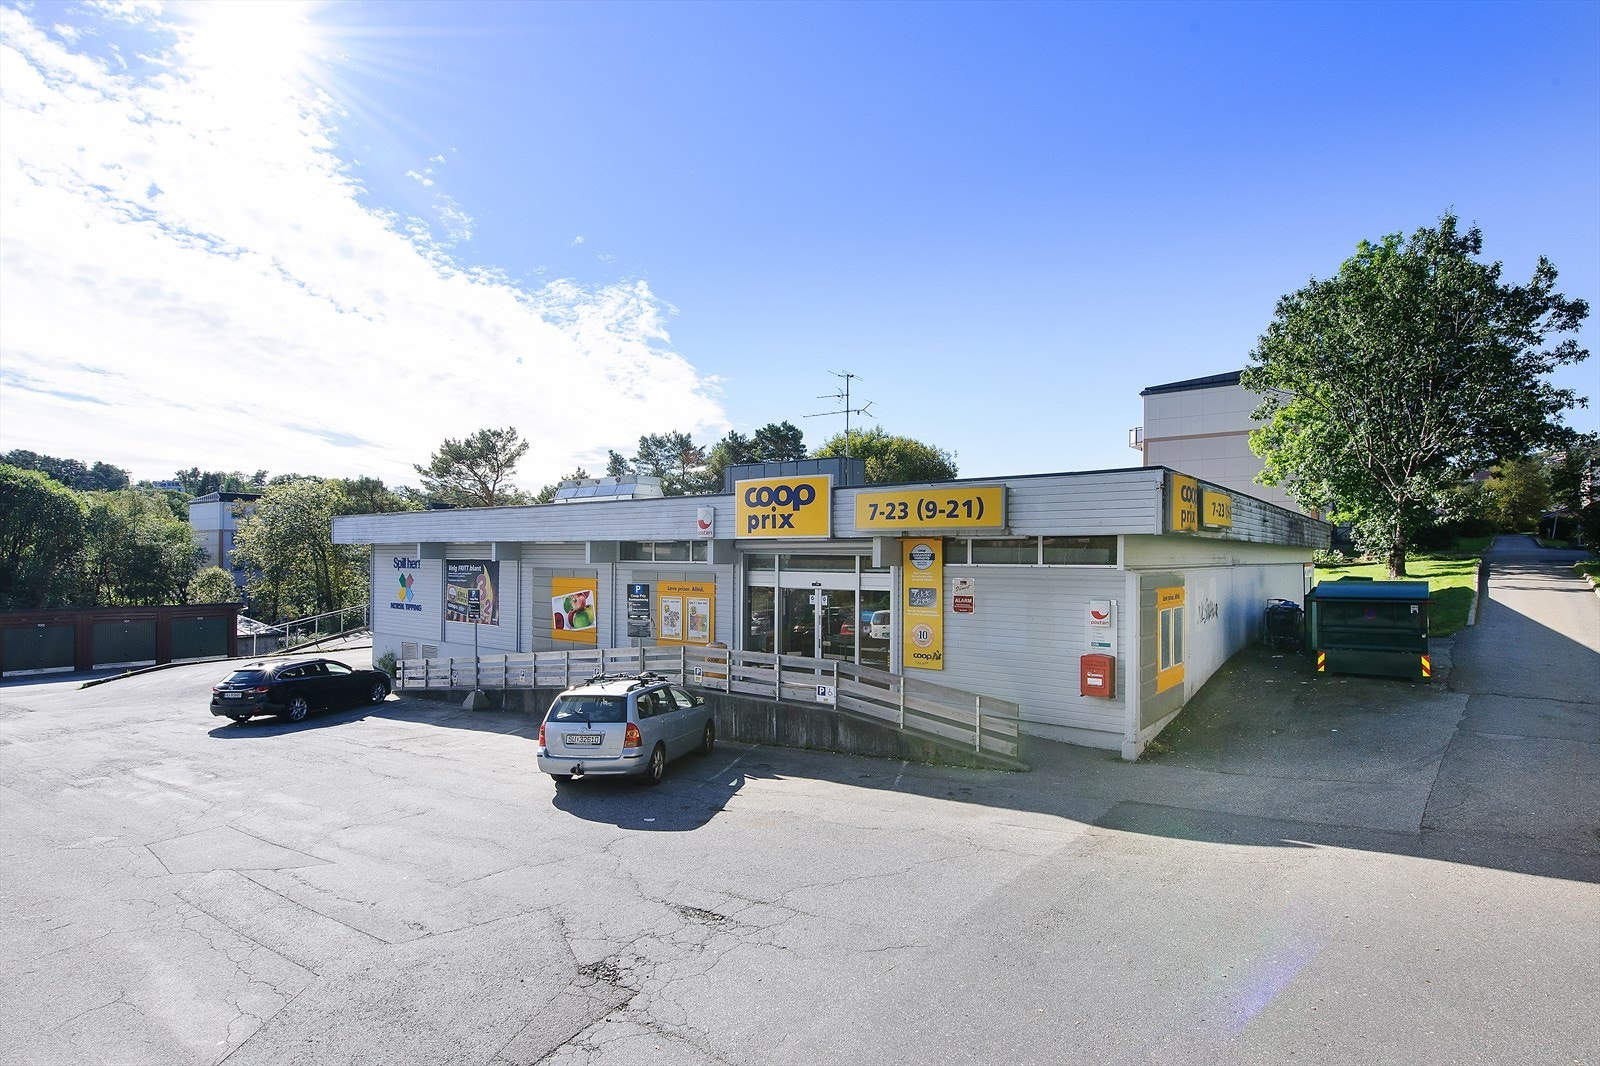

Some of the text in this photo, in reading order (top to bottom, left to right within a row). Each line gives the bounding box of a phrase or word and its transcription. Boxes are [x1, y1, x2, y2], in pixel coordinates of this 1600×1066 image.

[744, 483, 816, 511] coop
[868, 496, 985, 521] 7-23 (9-21)
[1180, 503, 1196, 528] prix
[1211, 501, 1225, 518] 7-23
[747, 506, 795, 533] prix
[393, 557, 407, 571] Spill
[458, 564, 469, 572] FRITT
[469, 564, 482, 572] blant
[476, 573, 487, 601] 3
[635, 585, 641, 593] P
[390, 602, 422, 612] NORSK TIPPING
[484, 599, 492, 615] 2
[919, 630, 928, 640] 10
[913, 652, 932, 660] coop
[819, 687, 825, 695] P
